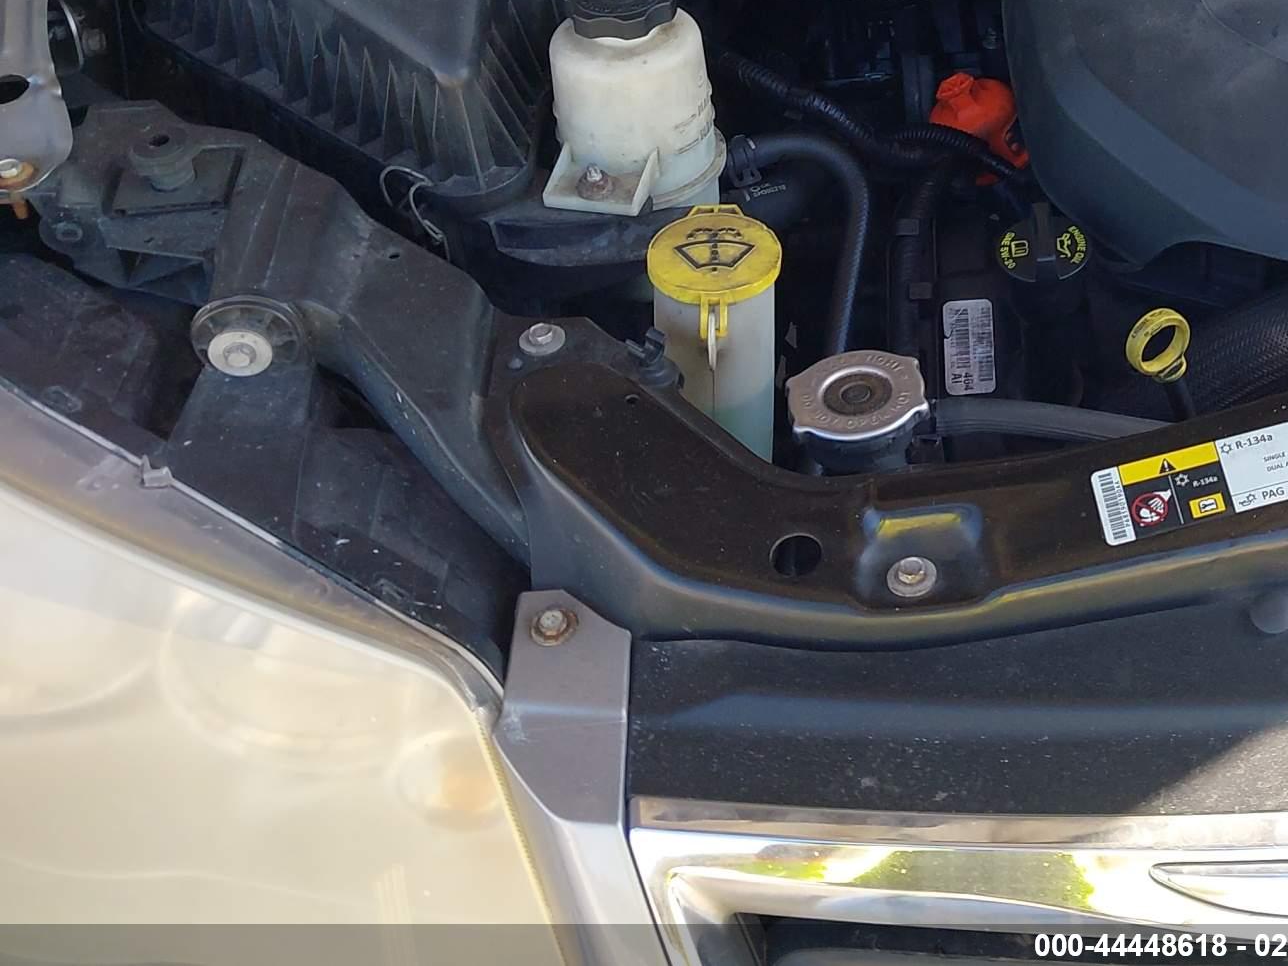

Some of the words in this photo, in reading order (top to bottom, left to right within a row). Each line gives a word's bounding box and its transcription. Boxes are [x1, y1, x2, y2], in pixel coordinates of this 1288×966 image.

[1000, 246, 1016, 269] 5W-20
[1235, 433, 1273, 451] R-134a
[1263, 450, 1286, 463] SINGLE
[1266, 462, 1284, 472] DUAL
[1192, 475, 1219, 488] R-134a
[1261, 486, 1285, 500] PAG
